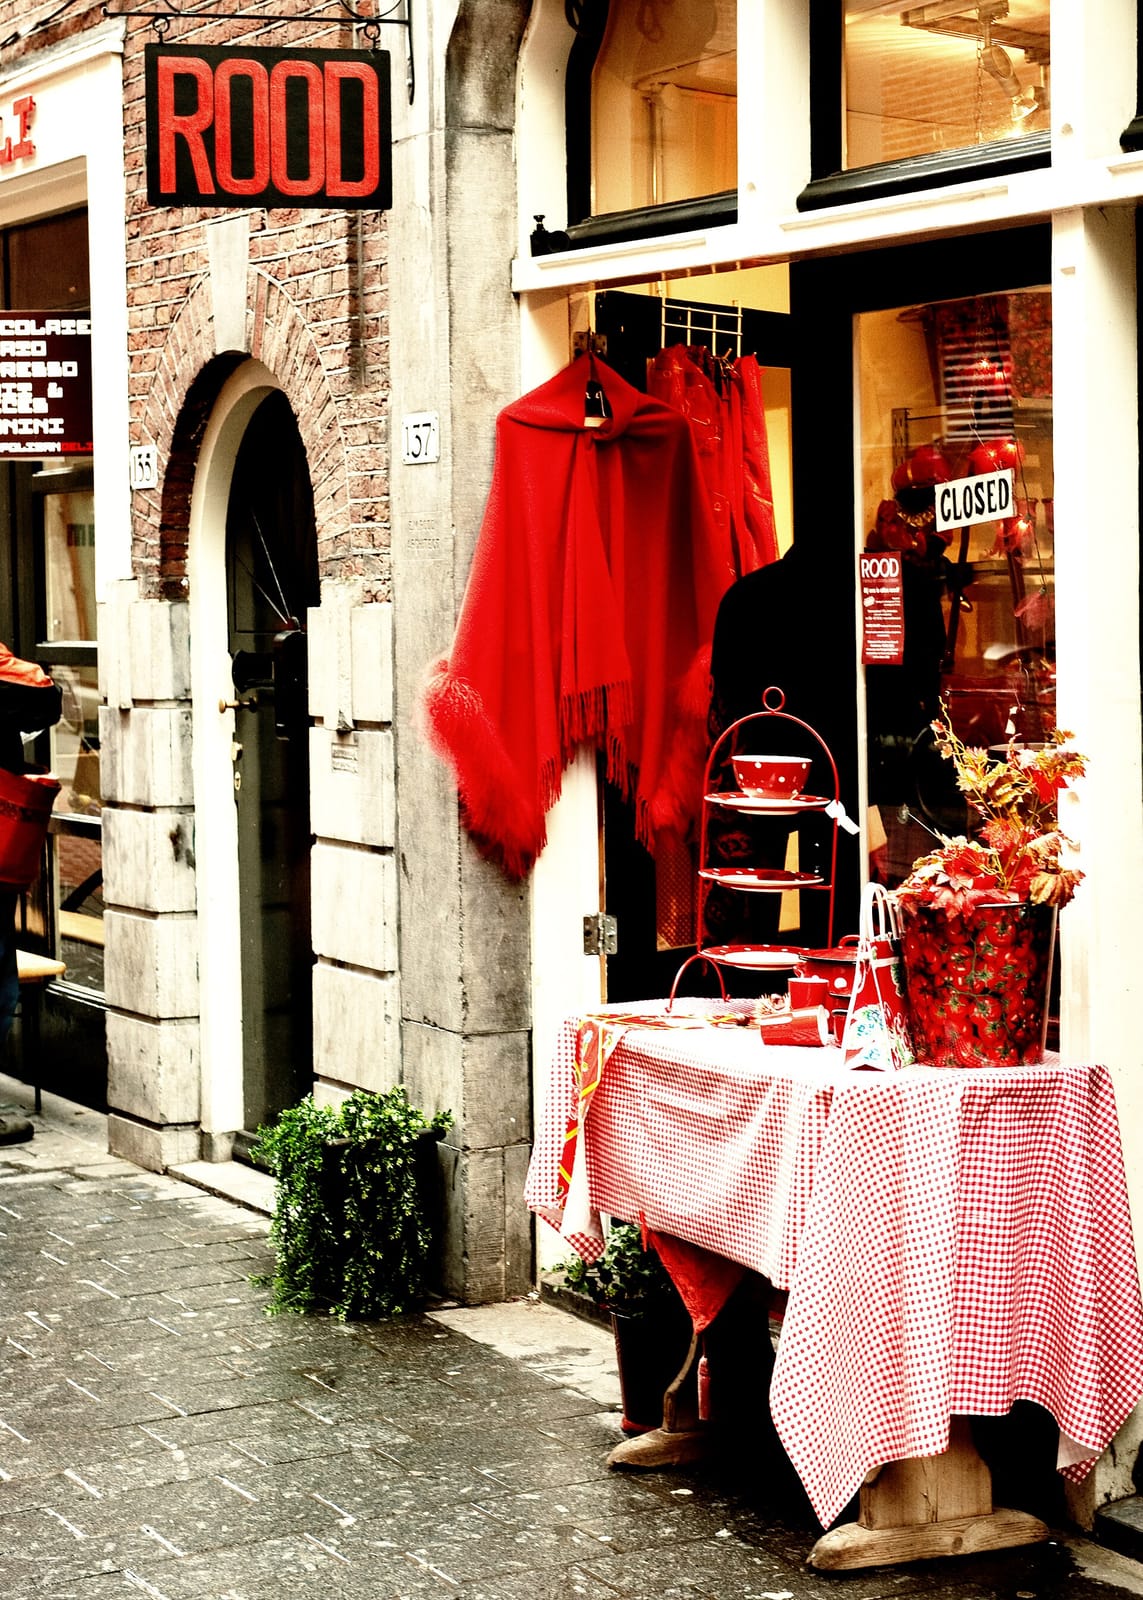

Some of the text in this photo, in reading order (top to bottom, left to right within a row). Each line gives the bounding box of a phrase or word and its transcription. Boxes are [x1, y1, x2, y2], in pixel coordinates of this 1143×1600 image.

[158, 56, 380, 197] ROOD
[0, 418, 64, 434] NINI
[405, 422, 432, 458] 157
[941, 478, 1009, 522] CLOSED
[861, 558, 899, 578] ROOD
